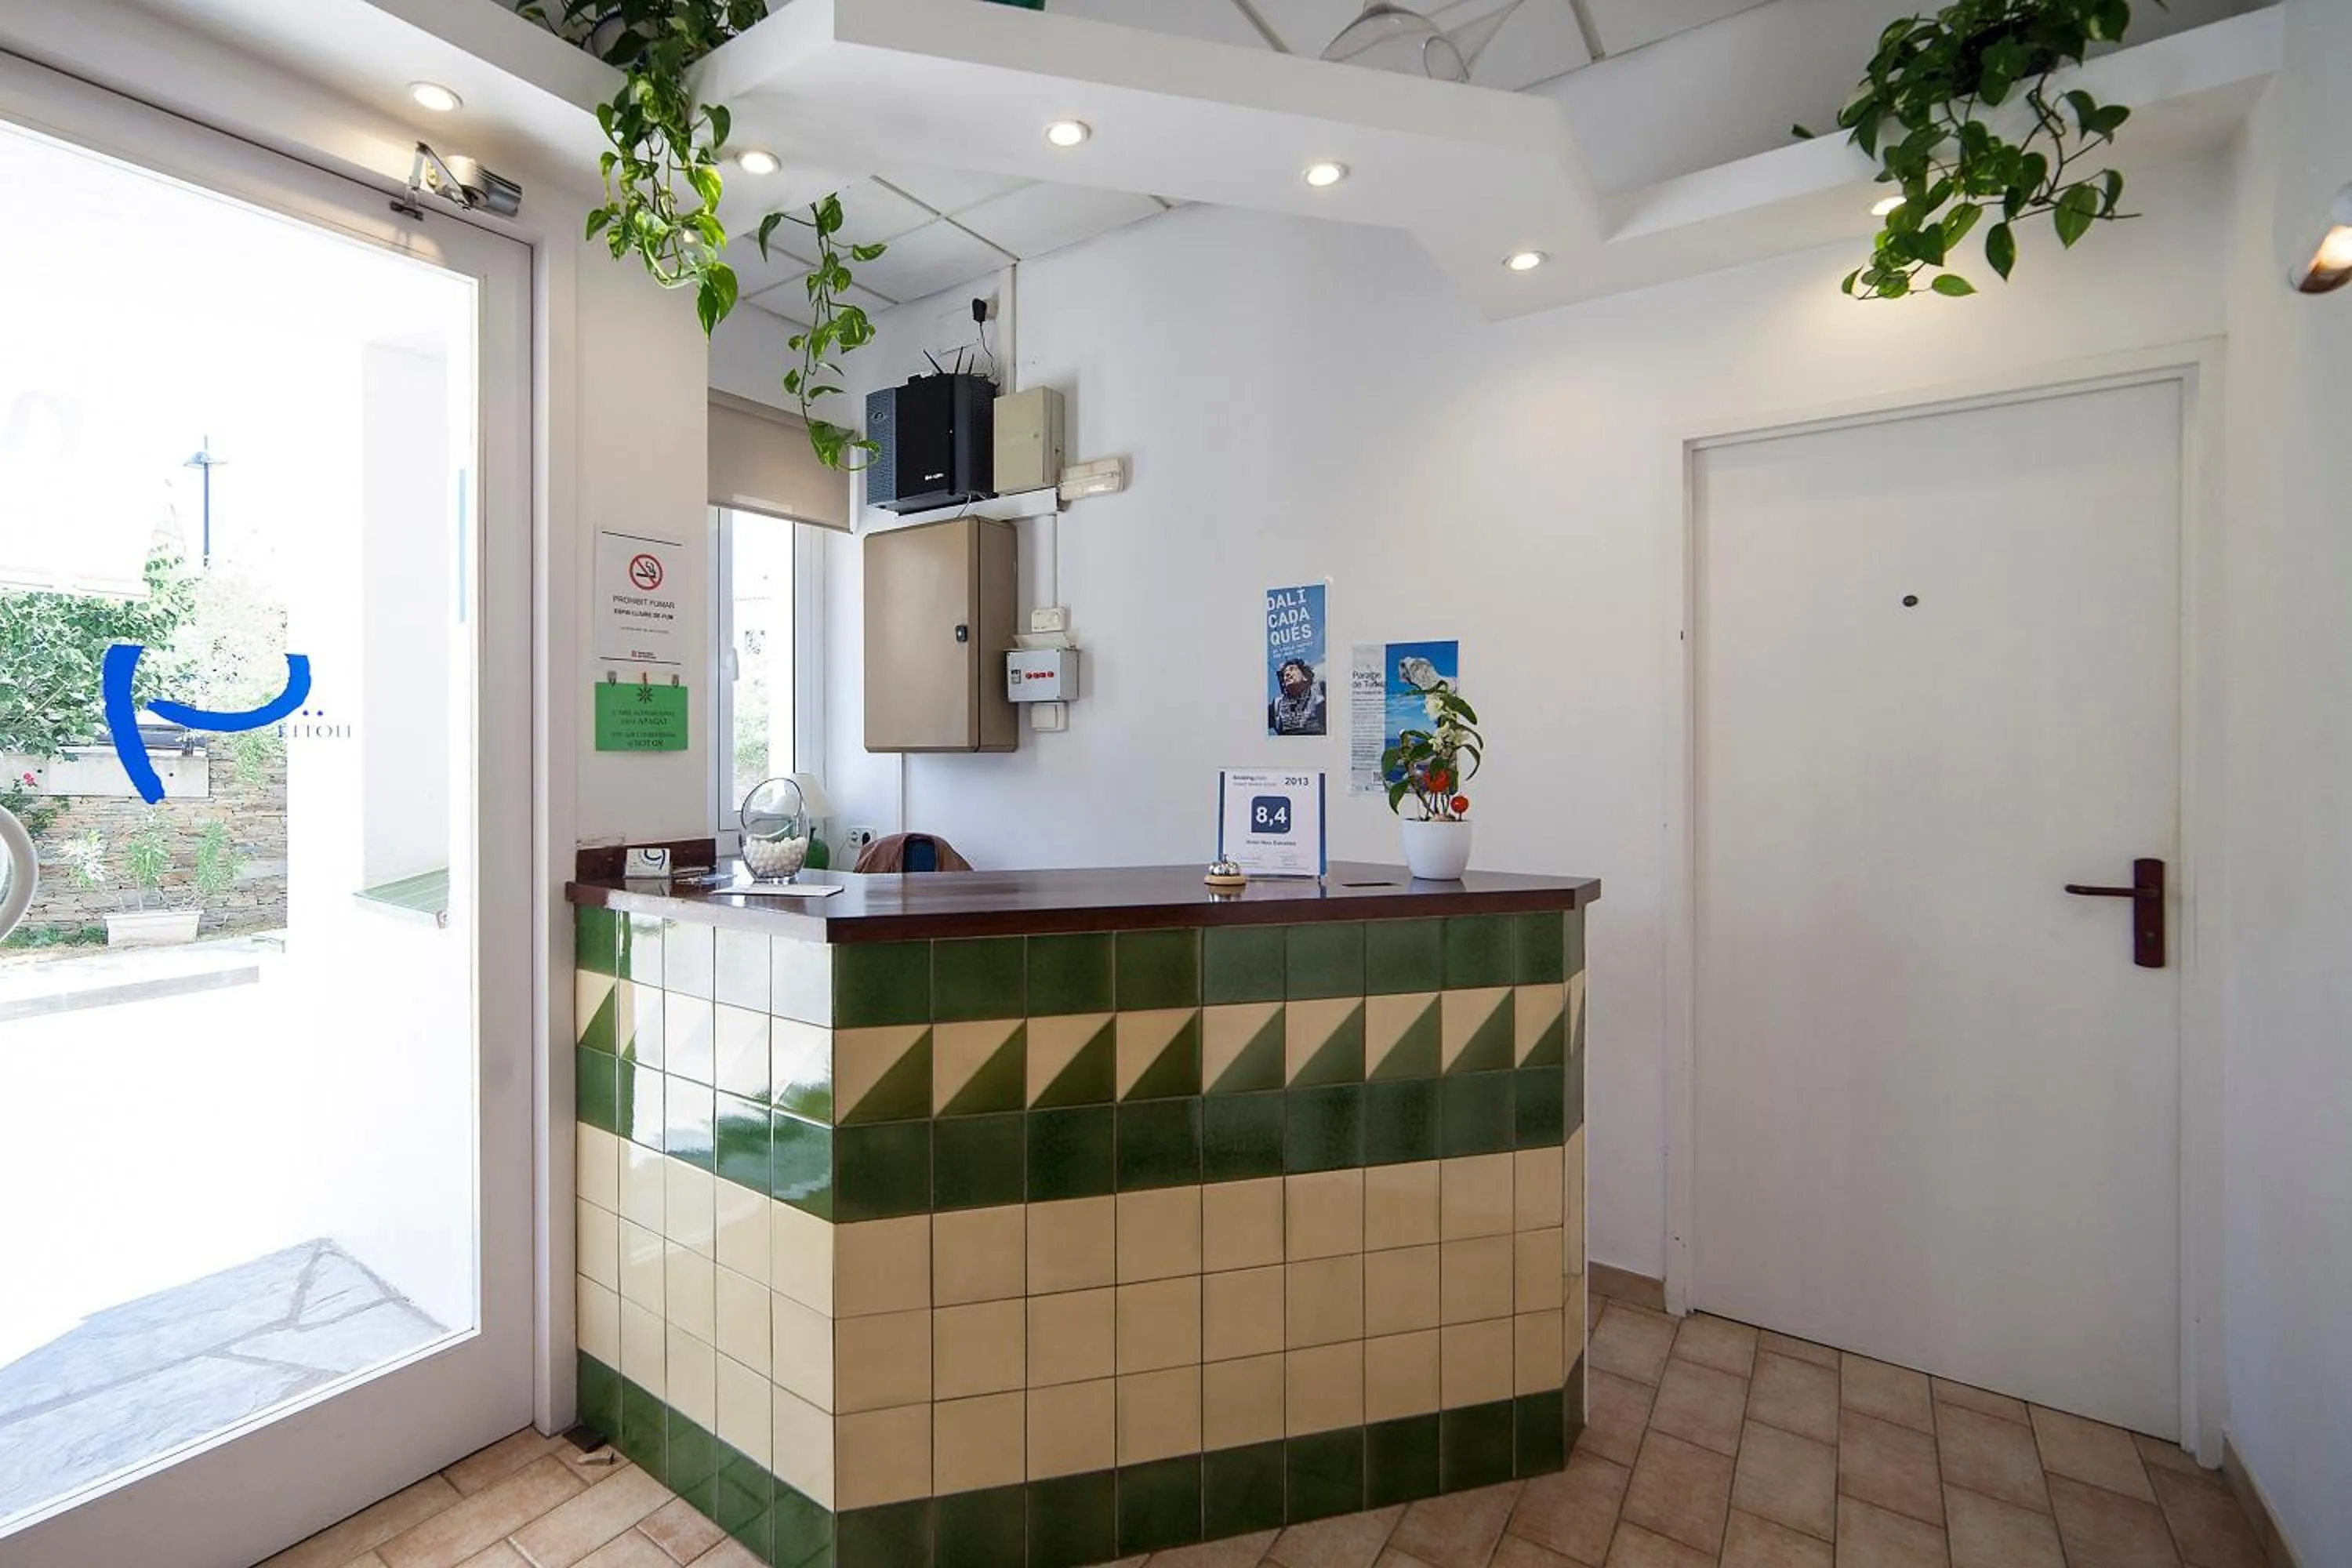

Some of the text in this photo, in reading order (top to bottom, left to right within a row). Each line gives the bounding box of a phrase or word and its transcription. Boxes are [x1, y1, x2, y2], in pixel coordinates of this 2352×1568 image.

[1269, 607, 1311, 628] CADA
[1285, 777, 1308, 786] 2013
[1255, 806, 1287, 826] 8,4
